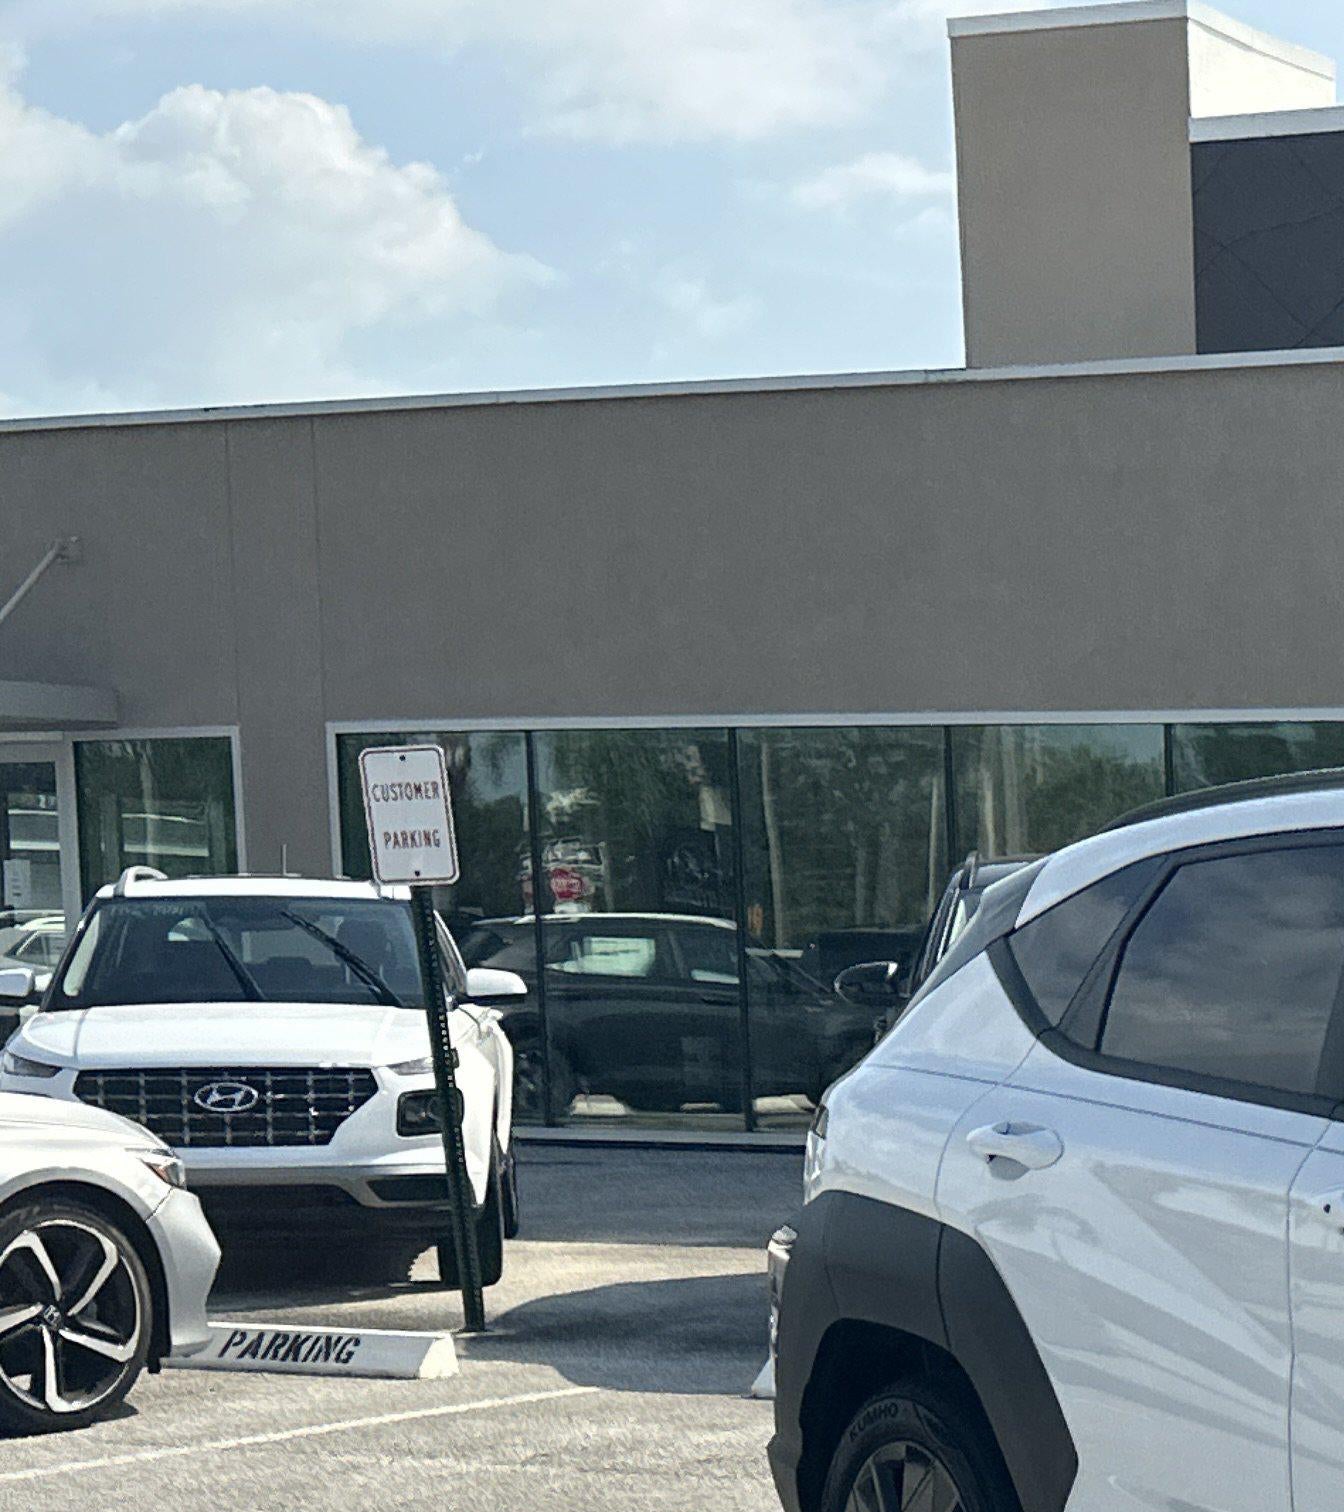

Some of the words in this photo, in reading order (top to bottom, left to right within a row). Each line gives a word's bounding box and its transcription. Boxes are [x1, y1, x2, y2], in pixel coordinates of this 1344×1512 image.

[371, 780, 440, 803] CUSTOMER
[383, 829, 441, 850] PARKING
[217, 1329, 361, 1364] PARKING
[850, 1402, 898, 1440] KUMHO
